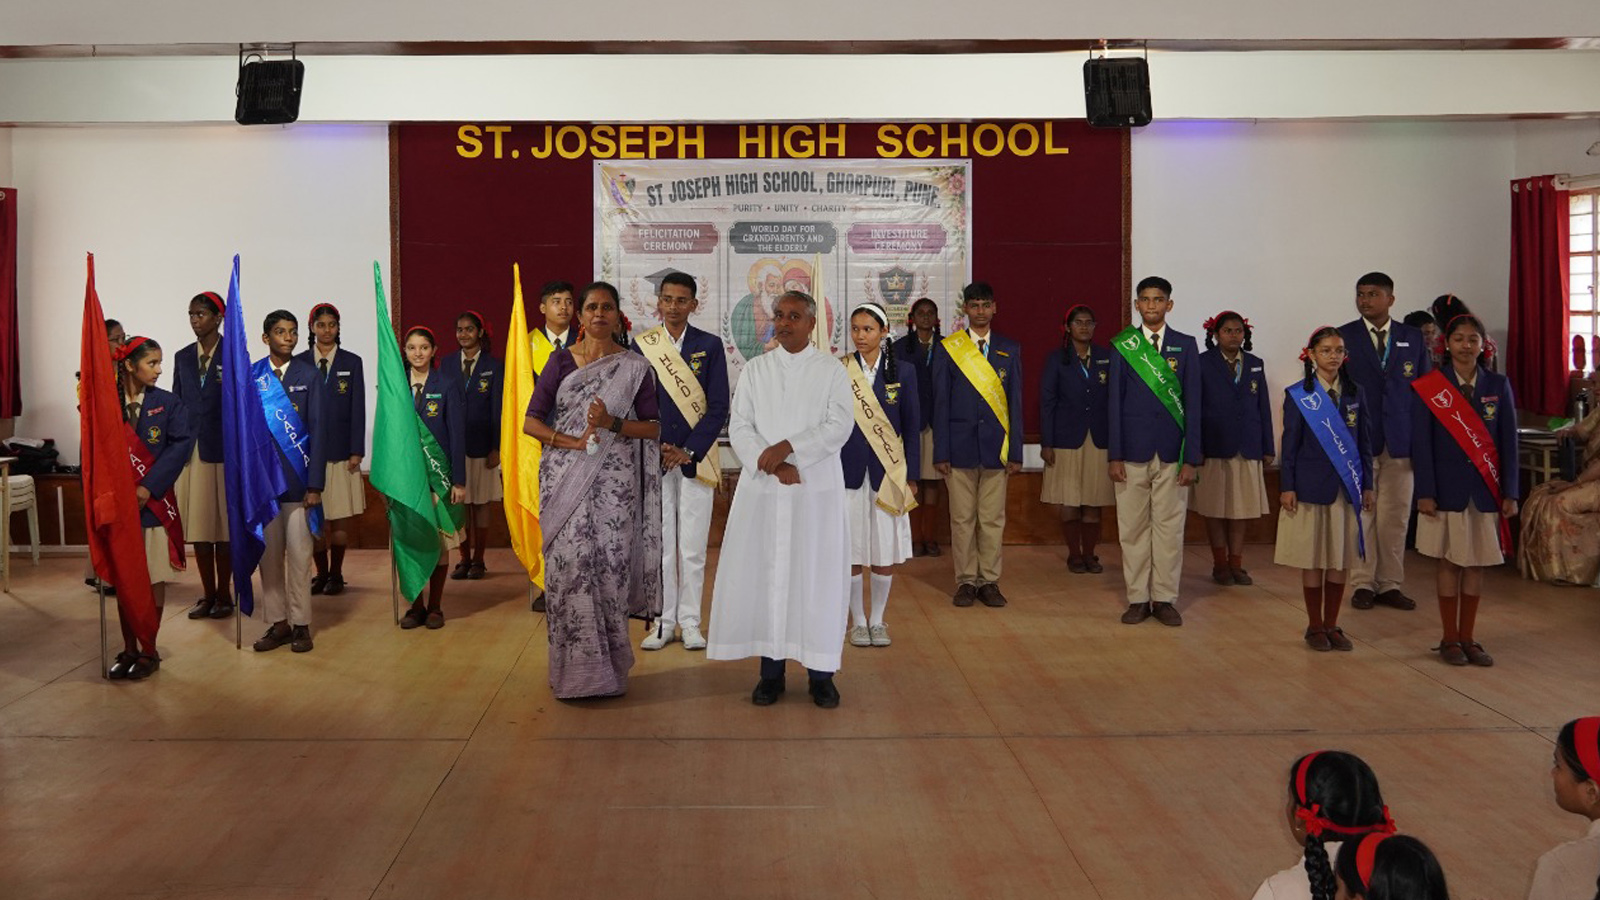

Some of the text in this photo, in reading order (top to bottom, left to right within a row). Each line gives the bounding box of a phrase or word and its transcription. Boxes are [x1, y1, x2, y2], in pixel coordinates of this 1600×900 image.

[456, 121, 1070, 159] ST. JOSEPH HIGH SCHOOL
[646, 183, 663, 207] ST
[668, 175, 721, 203] JOSEPH
[725, 171, 759, 195] HIGH
[763, 170, 824, 195] SCHOOL,
[732, 203, 847, 213] PURITY UNITY CHARITY
[638, 228, 701, 239] FELICITATION
[750, 225, 816, 234] WORLD DAY FOR
[870, 228, 929, 240] INVESTITURE
[743, 234, 825, 243] GRANDPARENTS AND
[643, 241, 694, 251] CEREMONY
[757, 243, 808, 252] THE ELDERLY
[874, 241, 924, 251] CEREMONY
[658, 353, 692, 398] HEAD
[851, 378, 900, 465] HEAD GIRL
